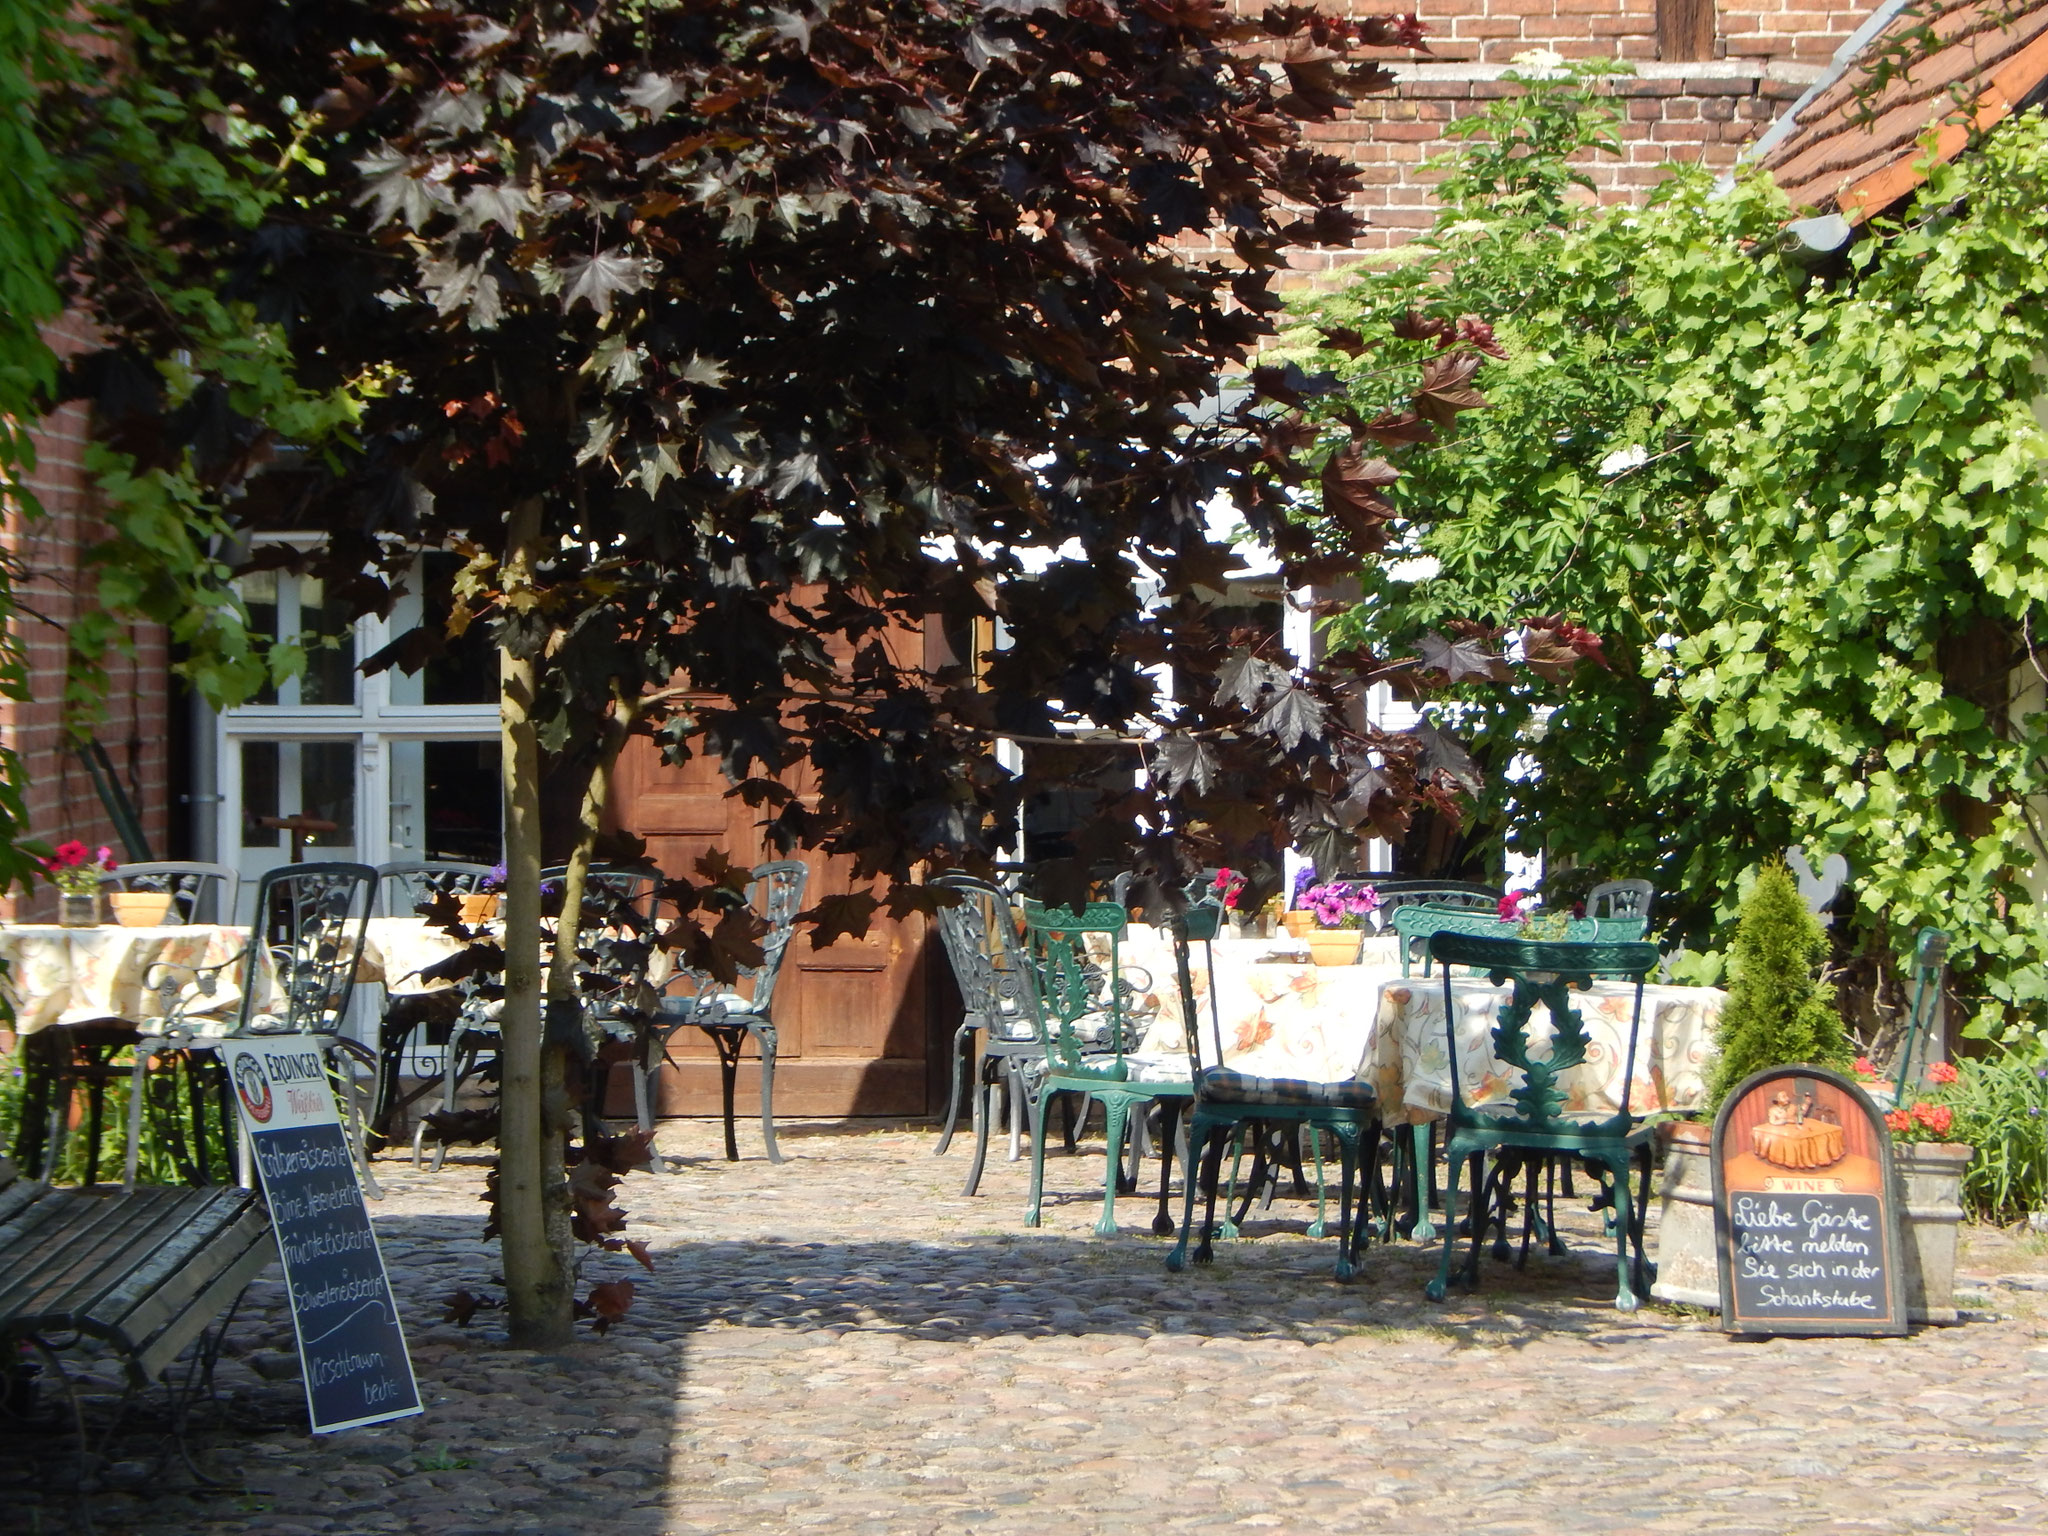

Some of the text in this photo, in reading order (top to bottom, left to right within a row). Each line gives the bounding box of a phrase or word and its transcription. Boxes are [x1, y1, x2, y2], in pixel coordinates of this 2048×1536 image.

[264, 1053, 326, 1083] ERDINGER
[1784, 1180, 1825, 1192] WINE
[1735, 1196, 1871, 1237] Liebe Gäste
[1738, 1232, 1869, 1255] bitte melden
[1742, 1256, 1880, 1279] Sie sich in der
[1757, 1285, 1876, 1310] Schankstube
